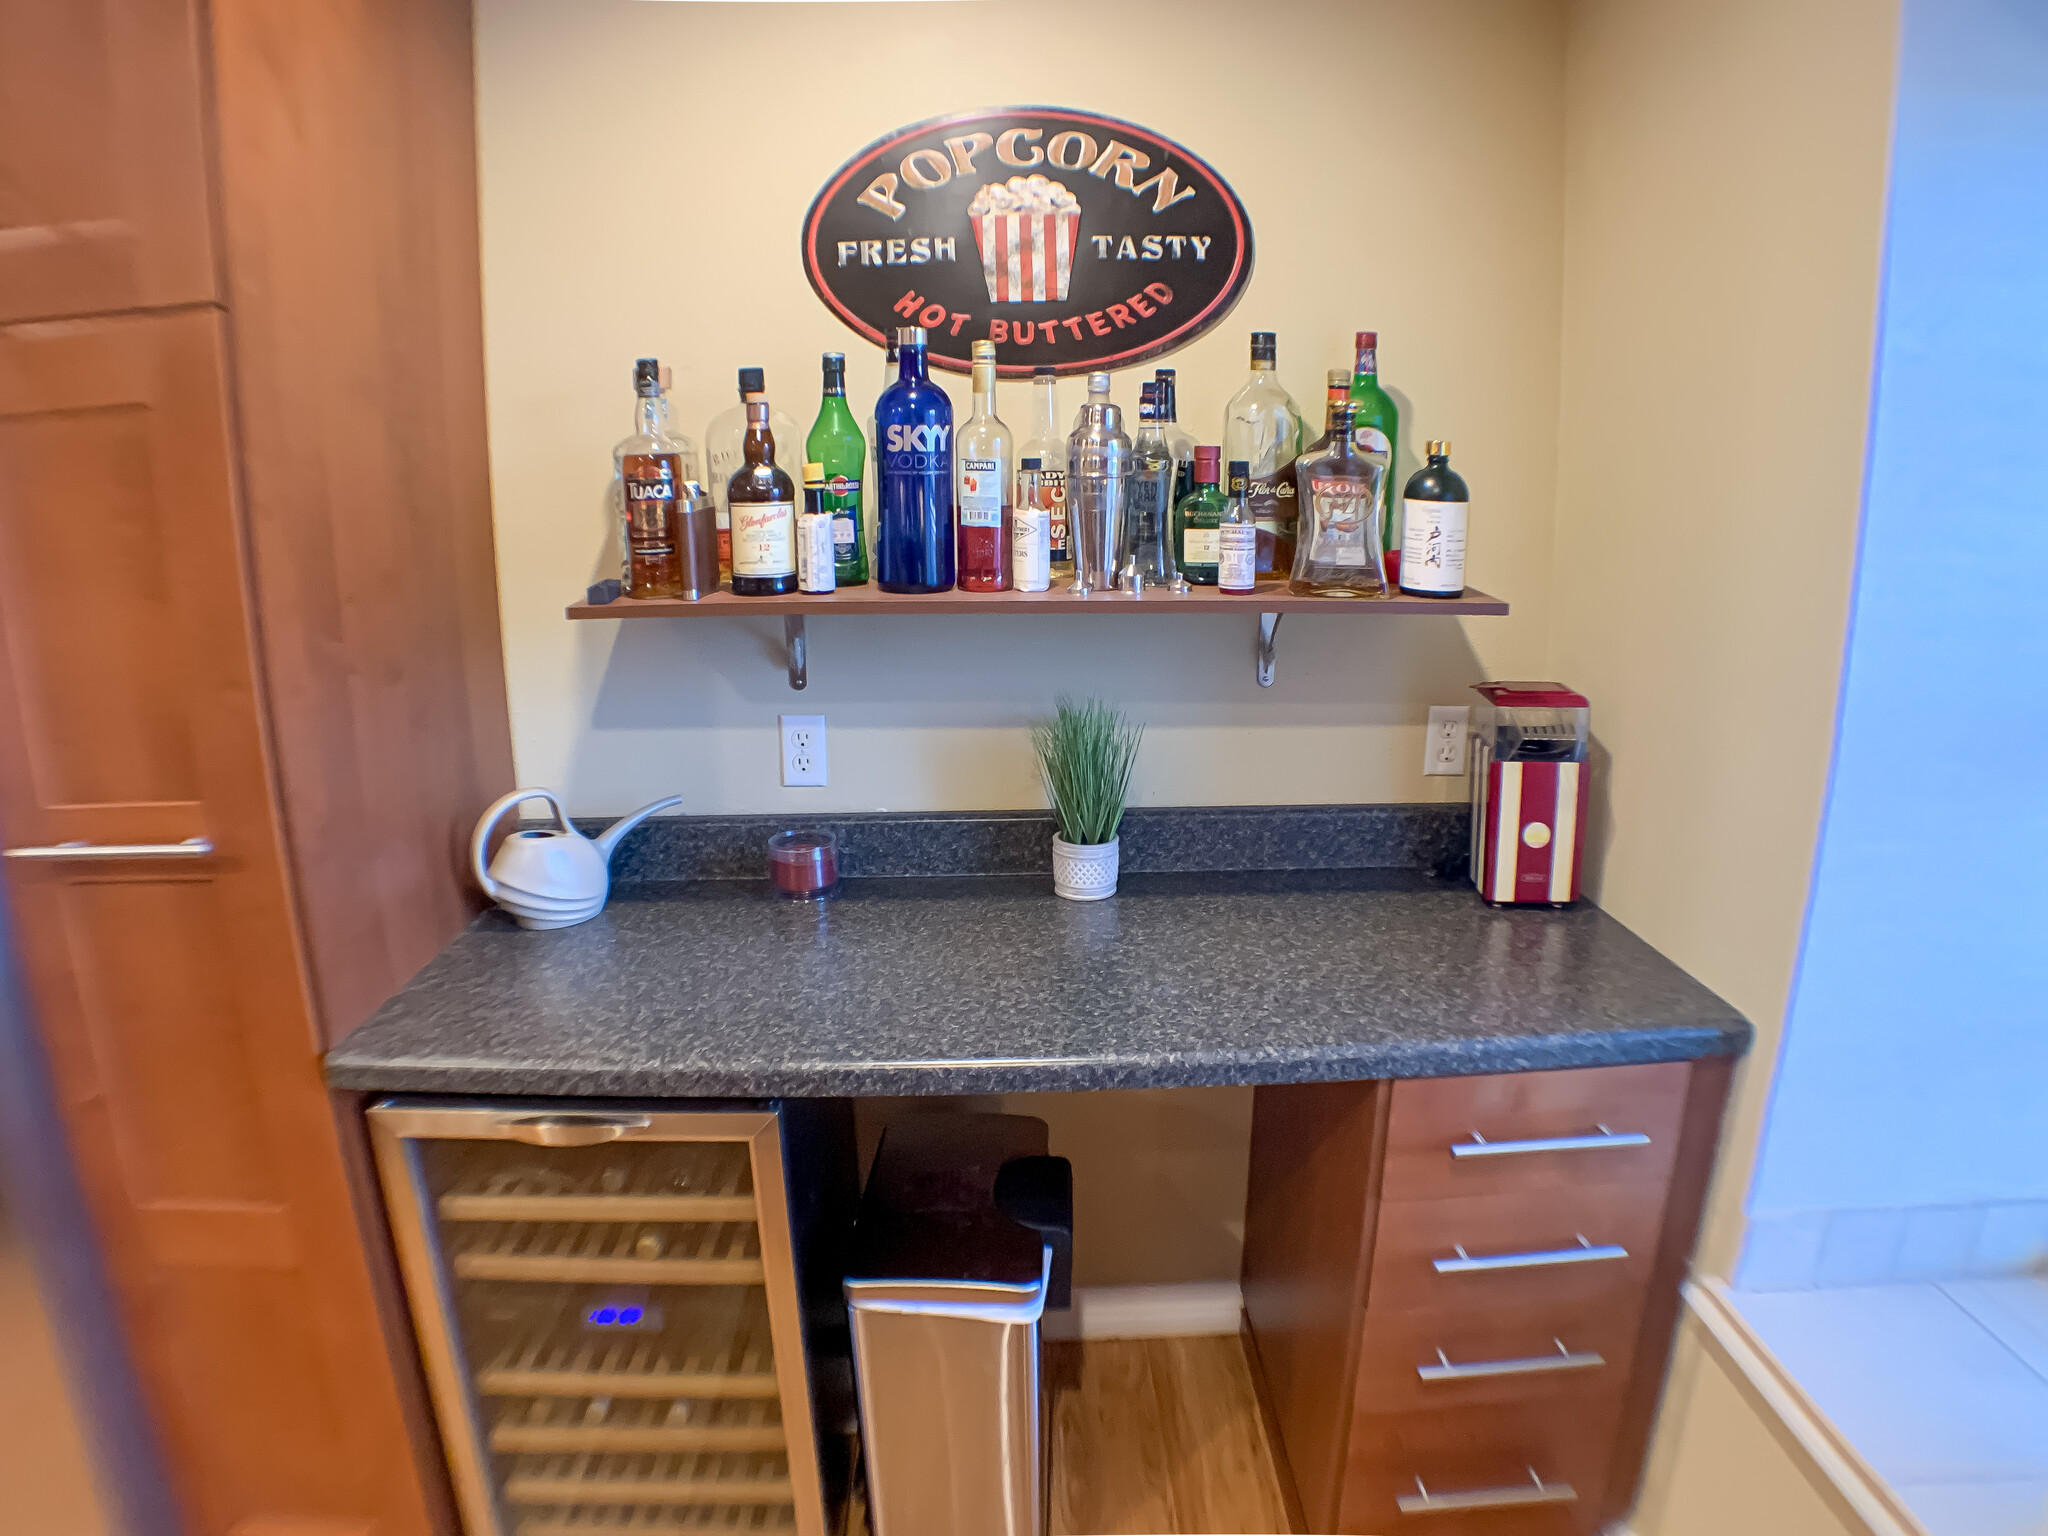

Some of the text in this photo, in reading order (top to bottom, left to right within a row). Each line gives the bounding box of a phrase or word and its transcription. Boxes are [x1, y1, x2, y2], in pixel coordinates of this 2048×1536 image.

[857, 128, 1196, 222] POPCORN
[837, 234, 1212, 267] FRESH TASTY
[893, 282, 1174, 346] HOT BUTTERED
[886, 424, 950, 453] SKYY
[886, 453, 948, 469] VODKA
[966, 461, 995, 470] CAMPARI
[627, 482, 673, 500] TUACA
[759, 544, 770, 552] 12
